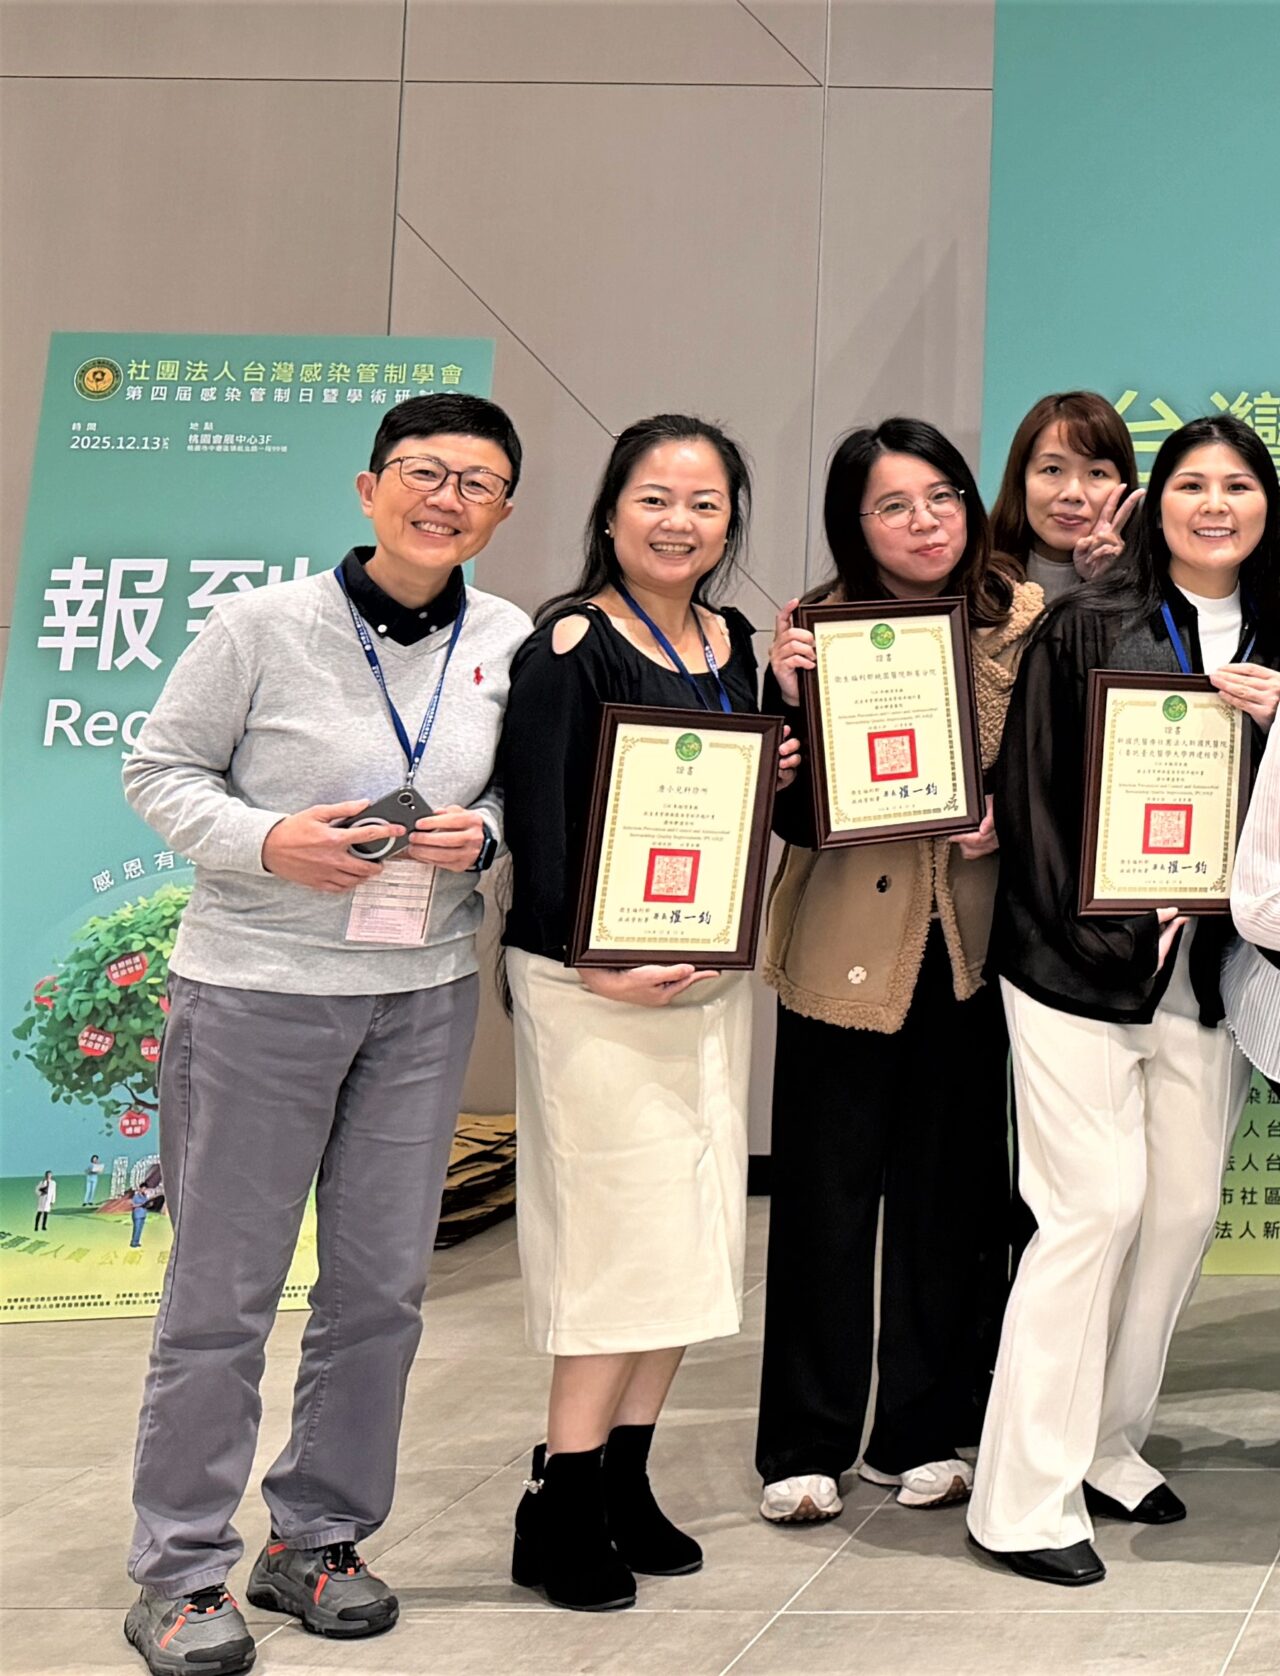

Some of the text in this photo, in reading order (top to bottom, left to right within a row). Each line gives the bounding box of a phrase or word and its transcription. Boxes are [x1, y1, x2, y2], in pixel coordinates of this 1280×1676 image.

[127, 359, 463, 385] 社團法人台灣感染管制學會
[125, 385, 459, 404] 第四屆感染管制日暨學術研
[70, 435, 161, 450] 2025.12.13
